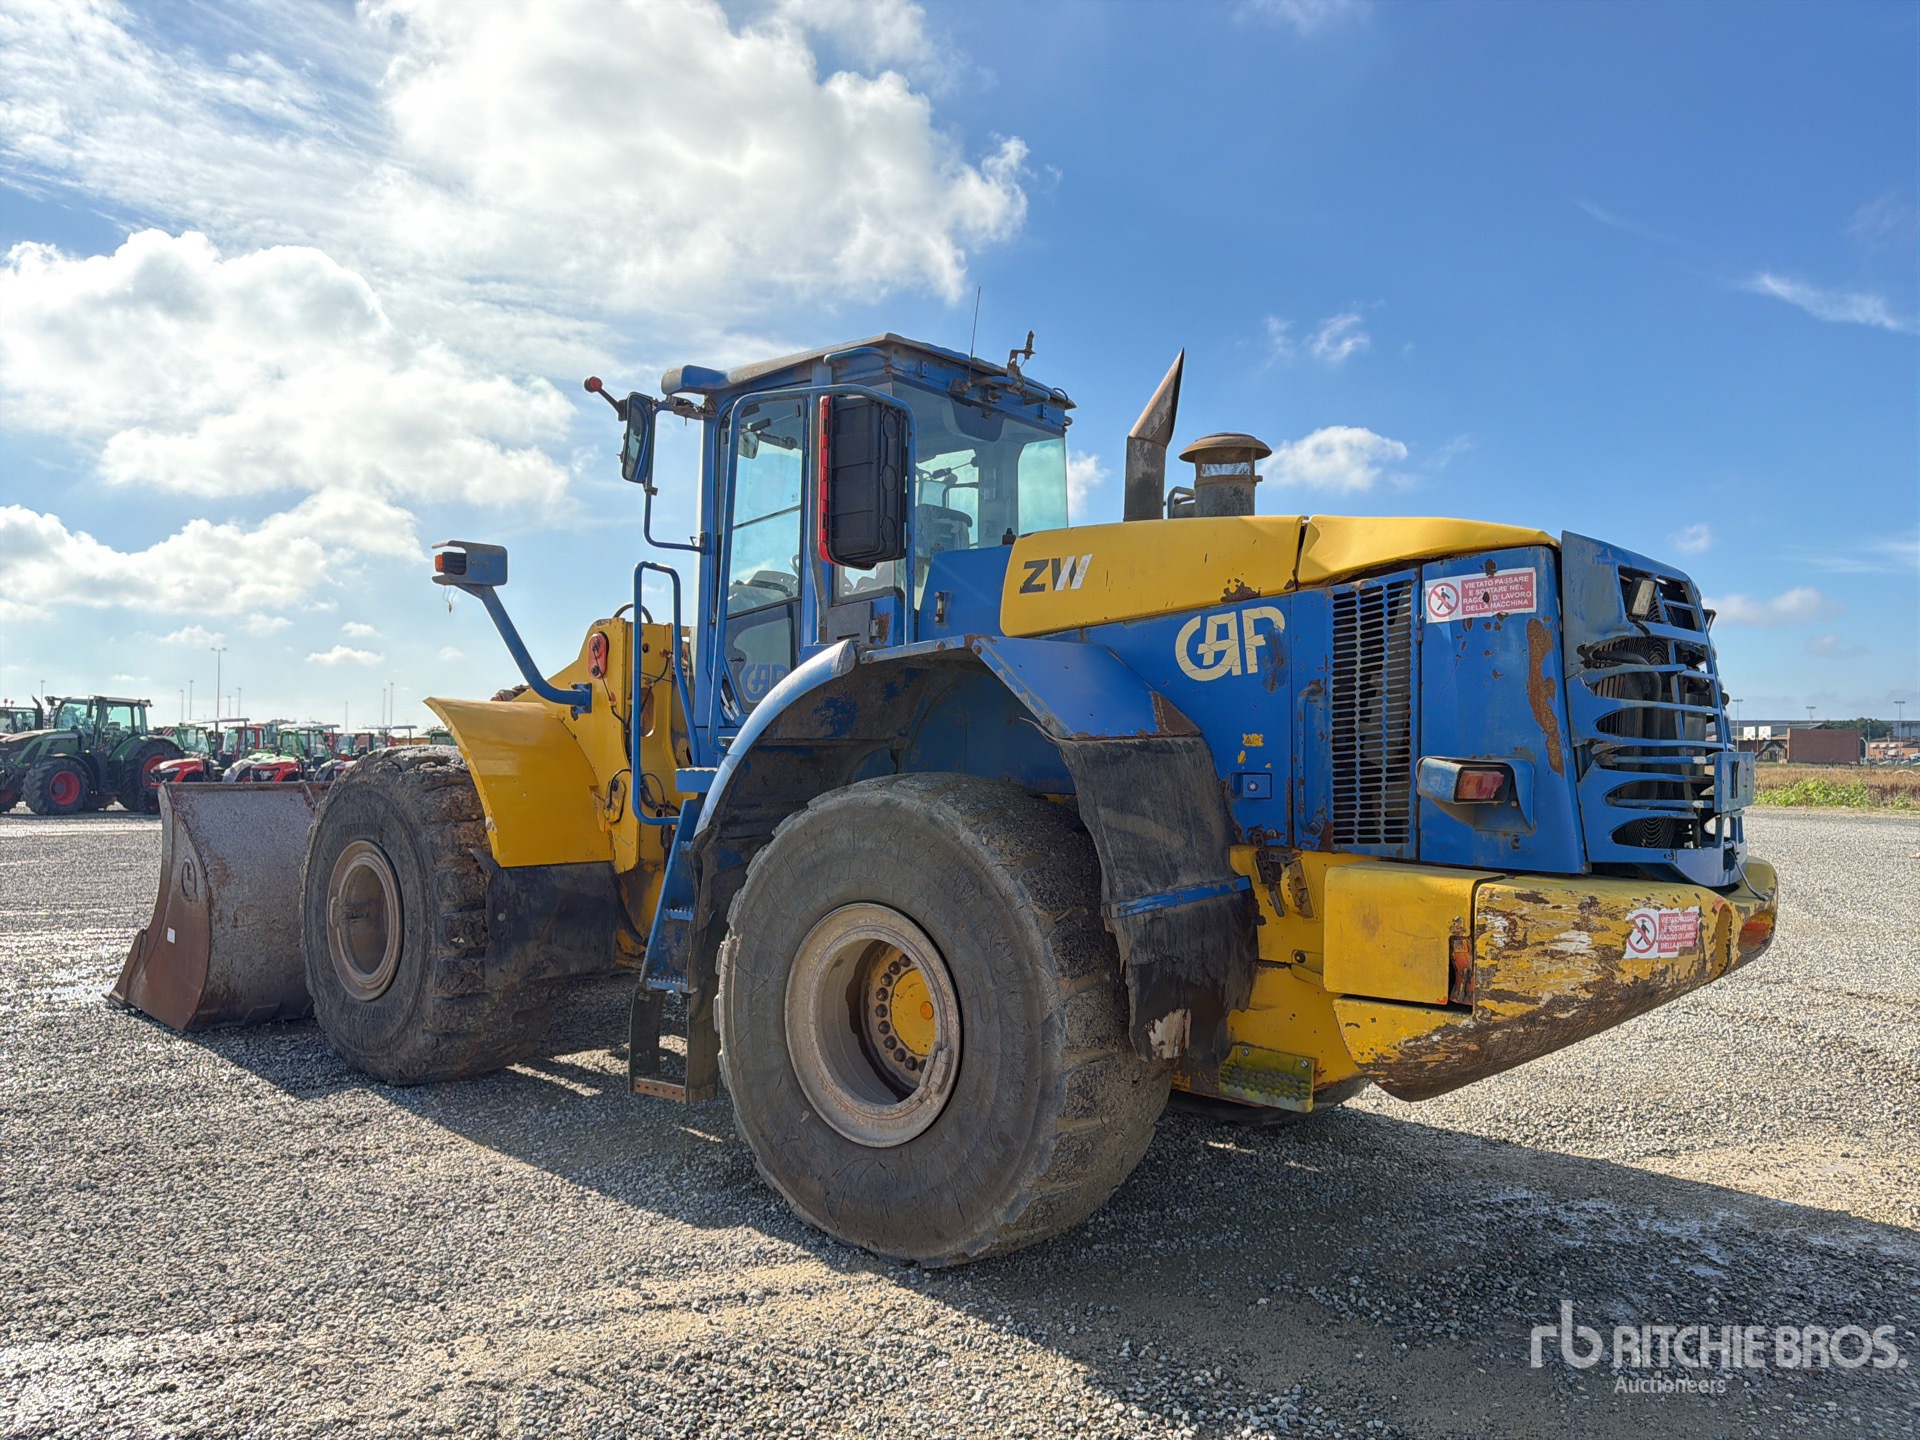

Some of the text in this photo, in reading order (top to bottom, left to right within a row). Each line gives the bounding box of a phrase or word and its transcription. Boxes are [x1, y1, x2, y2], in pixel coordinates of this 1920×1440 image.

[1019, 554, 1093, 594] ZW
[1464, 575, 1530, 589] VIETATO PASSARE
[1475, 585, 1508, 595] SOSTARE
[1463, 595, 1491, 604] RAGG
[1501, 591, 1532, 600] LAVORO
[1466, 599, 1529, 611] DELLA MACCHINA
